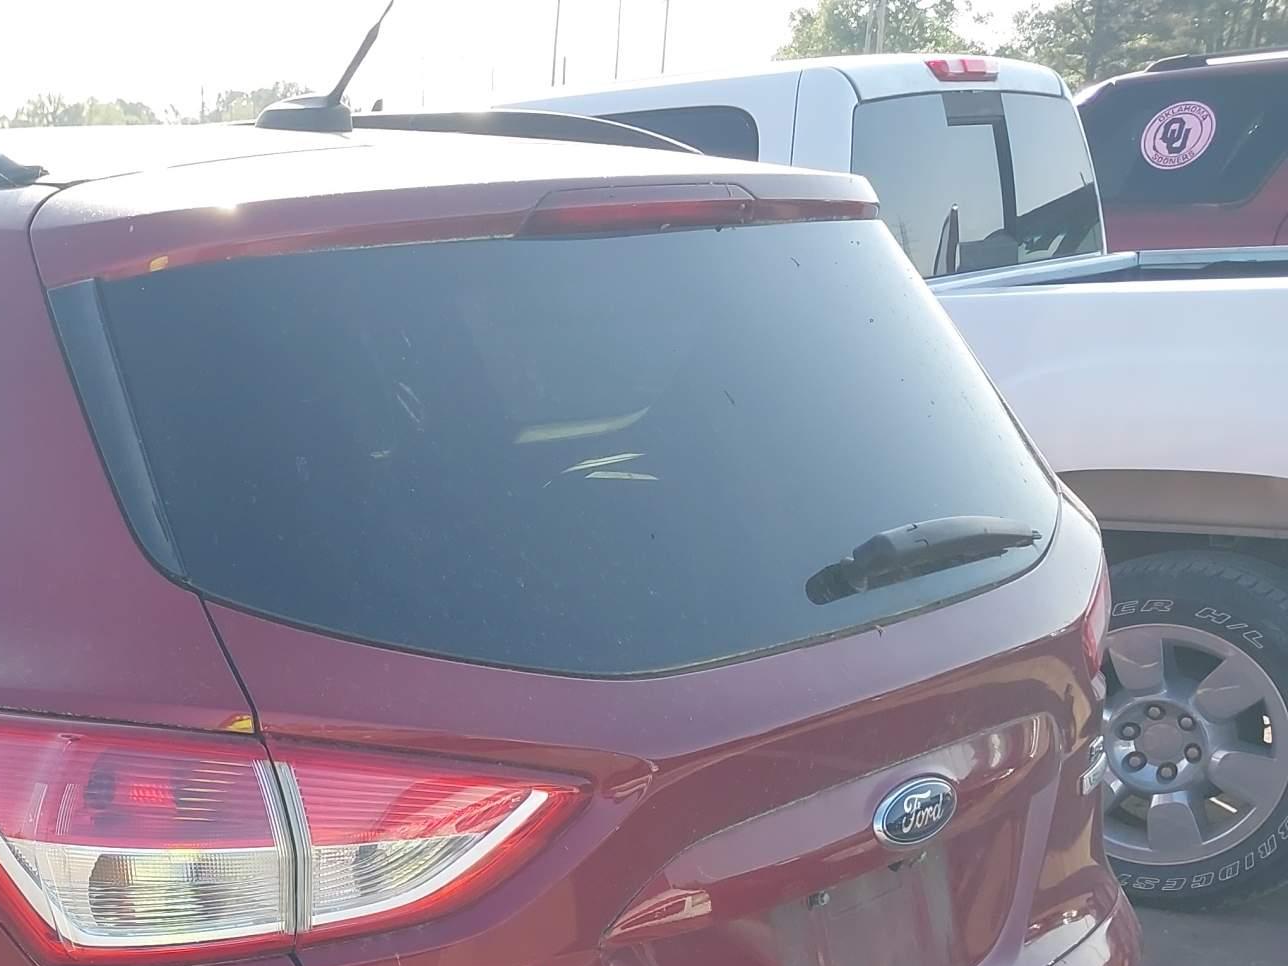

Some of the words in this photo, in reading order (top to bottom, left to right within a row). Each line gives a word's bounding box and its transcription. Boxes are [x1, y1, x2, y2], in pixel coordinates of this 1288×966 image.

[1158, 104, 1209, 123] OKLAHOMA
[1160, 117, 1192, 155] OU
[1152, 150, 1195, 165] SOONERS
[1111, 599, 1174, 617] ER
[1194, 607, 1264, 649] H/L
[902, 789, 945, 834] Ford
